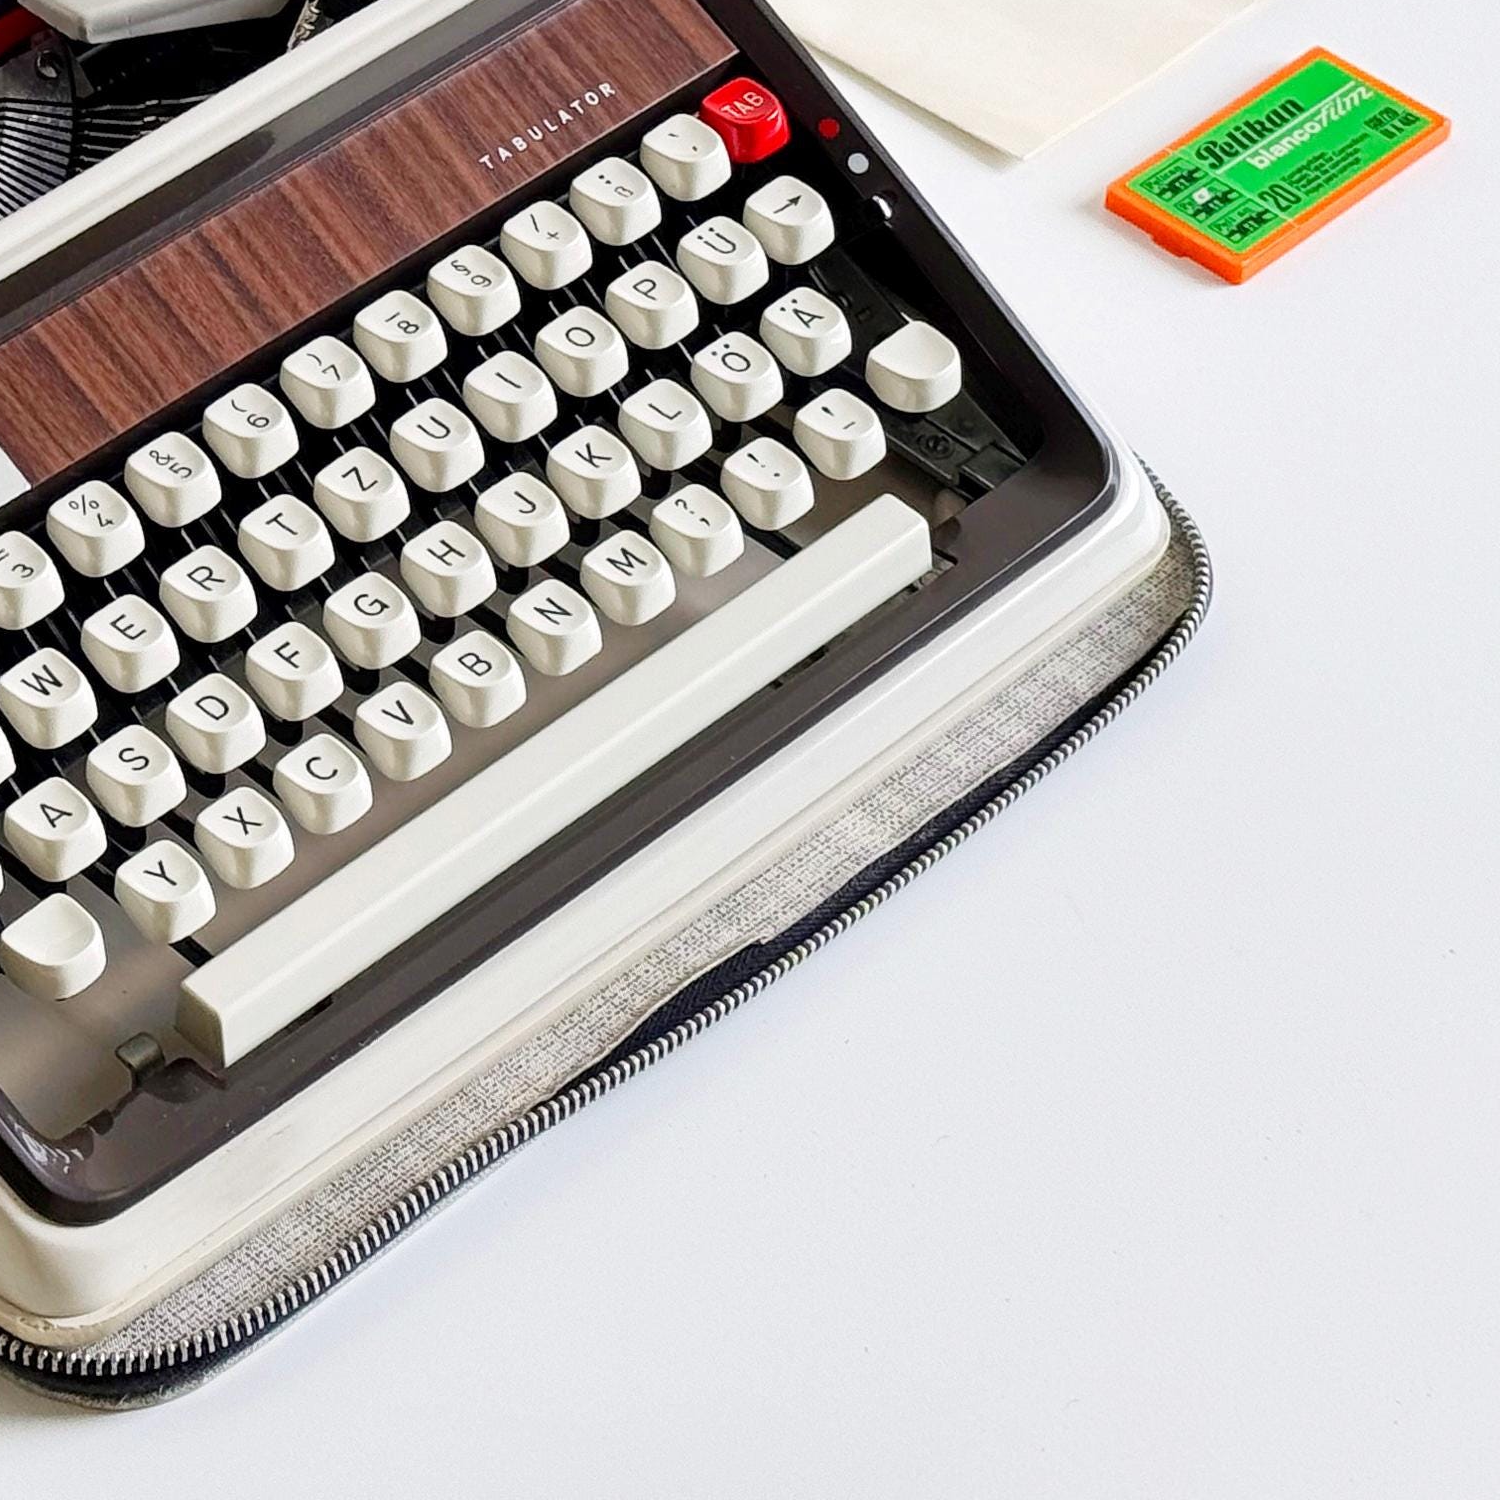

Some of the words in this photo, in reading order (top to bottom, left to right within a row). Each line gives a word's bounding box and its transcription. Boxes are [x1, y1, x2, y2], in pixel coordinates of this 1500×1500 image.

[720, 90, 765, 118] TAB
[479, 81, 617, 171] TABULATOR
[1195, 99, 1305, 170] Pelikan
[1257, 183, 1302, 212] 20
[697, 226, 736, 254] Ü
[470, 275, 492, 288] 9
[632, 279, 658, 301] P
[779, 298, 825, 328] Ä
[397, 320, 420, 334] 8
[565, 327, 595, 347] O
[711, 343, 751, 372] Ö
[322, 364, 341, 381] 7
[247, 414, 270, 428] 6
[648, 402, 683, 420] L
[417, 416, 451, 439] U
[575, 442, 612, 468] K
[169, 462, 192, 479] 5
[342, 466, 378, 491] Z
[513, 490, 537, 514] J
[97, 513, 113, 527] 4
[265, 512, 299, 536] T
[426, 539, 466, 567] H
[606, 547, 648, 576] M
[12, 564, 34, 578] 3
[187, 566, 226, 591] R
[354, 593, 389, 616] G
[533, 597, 573, 625] N
[110, 614, 147, 640] E
[273, 641, 301, 669] F
[458, 652, 492, 677] B
[20, 665, 64, 696] W
[198, 695, 230, 720] D
[381, 700, 415, 726] V
[118, 747, 150, 771] S
[305, 756, 338, 780] C
[40, 803, 72, 827] A
[222, 806, 263, 835] X
[143, 860, 178, 886] Y
